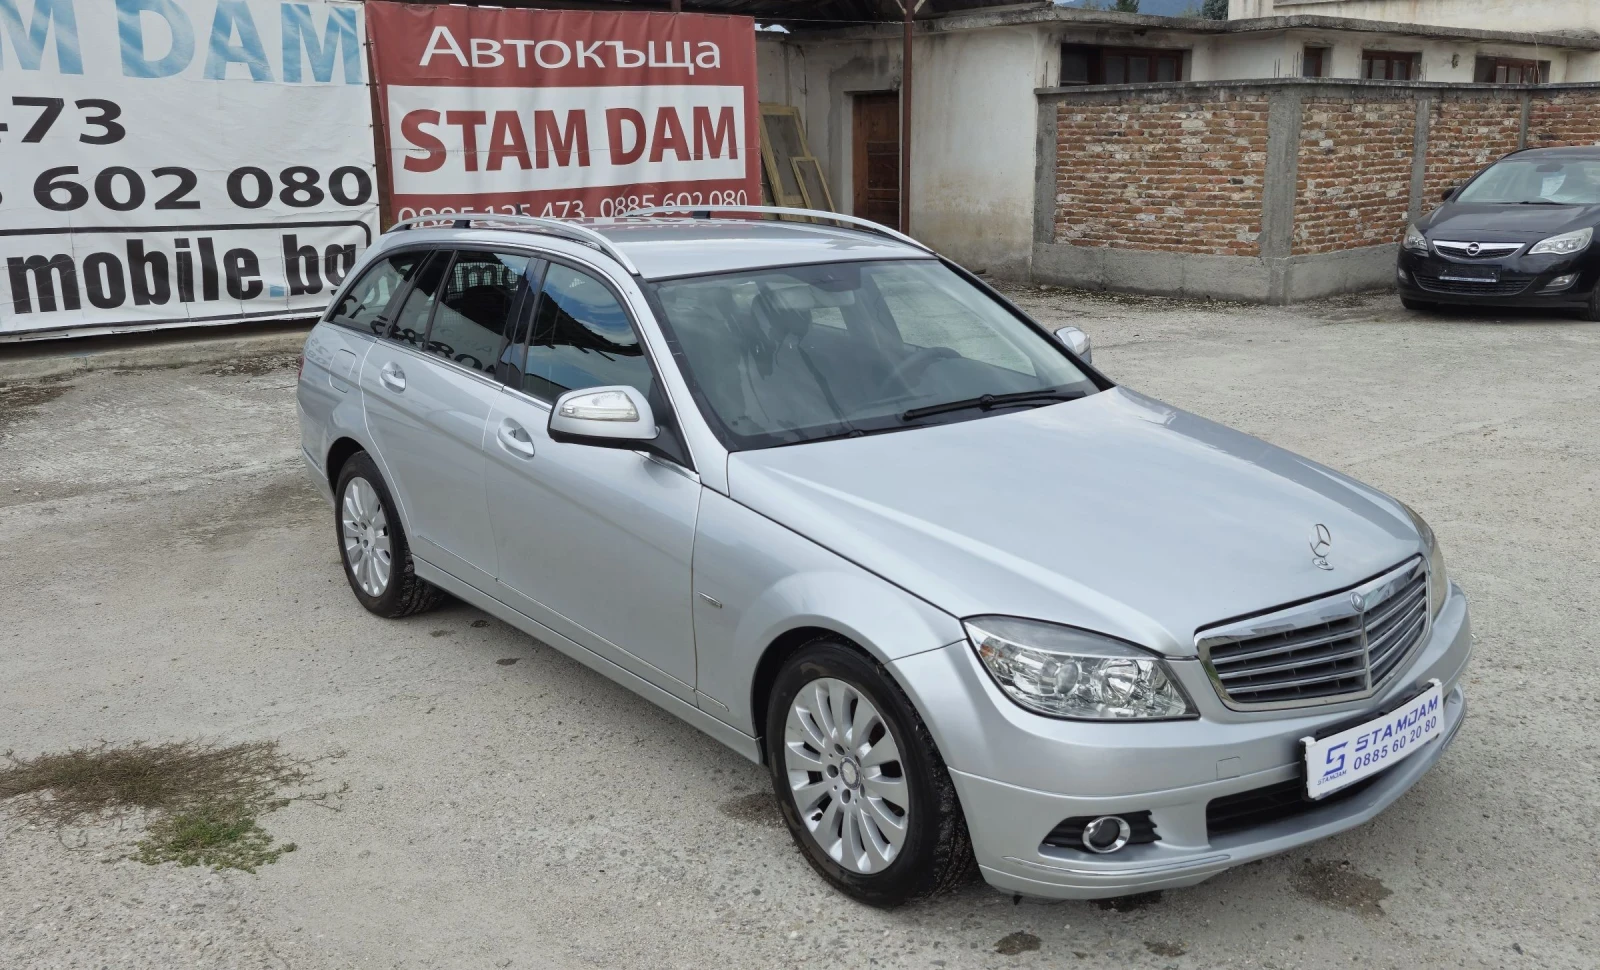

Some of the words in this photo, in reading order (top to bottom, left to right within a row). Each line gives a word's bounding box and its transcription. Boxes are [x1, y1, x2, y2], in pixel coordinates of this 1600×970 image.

[116, 0, 363, 85] DAM
[419, 26, 721, 76] Автокъща
[0, 97, 126, 145] 73
[400, 109, 591, 173] STAM
[605, 106, 739, 165] DAM
[33, 166, 201, 211] 602
[226, 165, 373, 209] 080
[1353, 744, 1388, 770] 0885
[1392, 737, 1406, 753] 60
[1410, 725, 1422, 744] 20
[1424, 716, 1437, 733] 80
